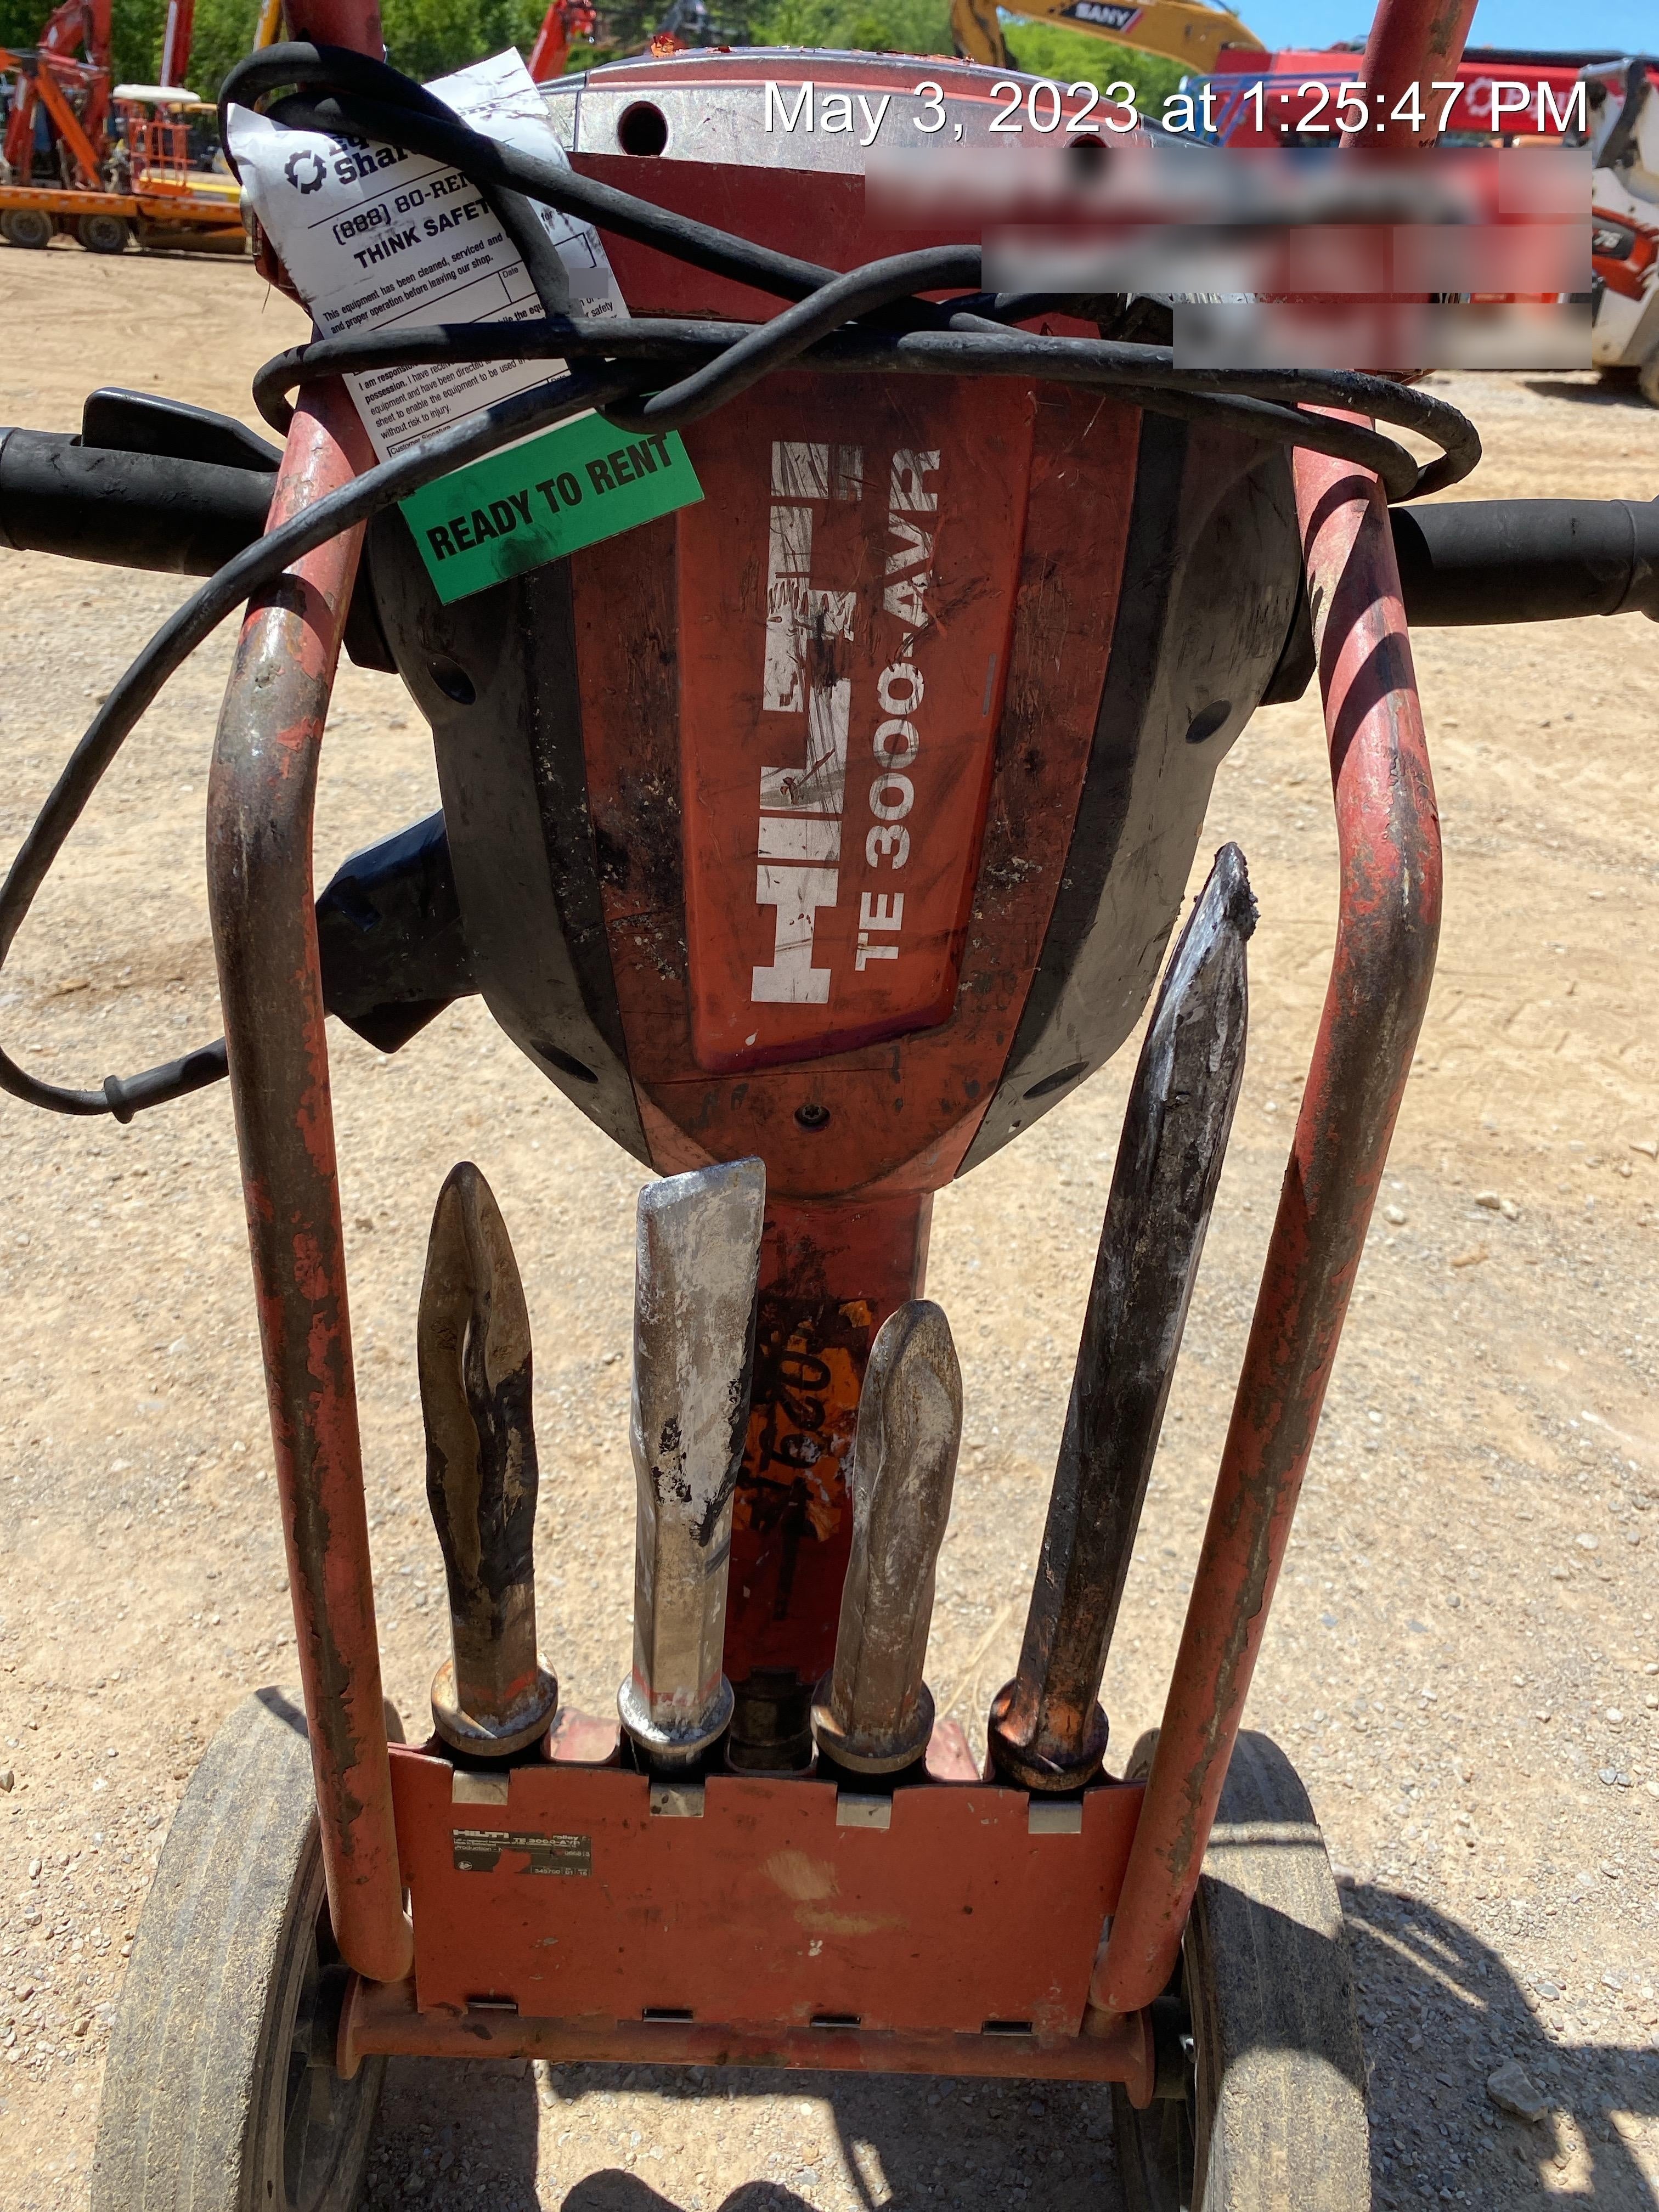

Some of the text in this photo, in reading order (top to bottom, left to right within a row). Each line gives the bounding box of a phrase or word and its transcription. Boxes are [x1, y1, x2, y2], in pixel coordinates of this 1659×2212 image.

[1075, 2, 1130, 27] SANY
[332, 204, 392, 246] (888)
[354, 226, 421, 268] THINK
[323, 232, 504, 322] This equipment has been cleaned, serviced and
[503, 266, 519, 278] Date
[330, 255, 494, 334] and proper operation before leaving our shop.
[514, 310, 527, 321] the
[590, 301, 613, 317] safety
[358, 382, 363, 391] I
[365, 378, 377, 388] am
[365, 380, 408, 404] possession.
[408, 375, 411, 383] I
[412, 369, 430, 382] have
[370, 393, 407, 415] equipment
[407, 387, 421, 399] and
[421, 381, 438, 393] have
[438, 372, 455, 386] been
[456, 361, 484, 377] directed
[376, 413, 396, 427] sheet
[397, 410, 404, 419] to
[406, 399, 429, 415] enable
[430, 394, 442, 404] the
[443, 376, 479, 398] equipment
[479, 374, 488, 382] to
[488, 368, 498, 378] be
[500, 359, 517, 373] used
[381, 404, 452, 439] without risk to injury.
[426, 436, 673, 561] READY TO RENT
[751, 441, 864, 1003] HILTI
[855, 448, 941, 972] TE 3000-AVR
[453, 1829, 510, 1838] HILTI
